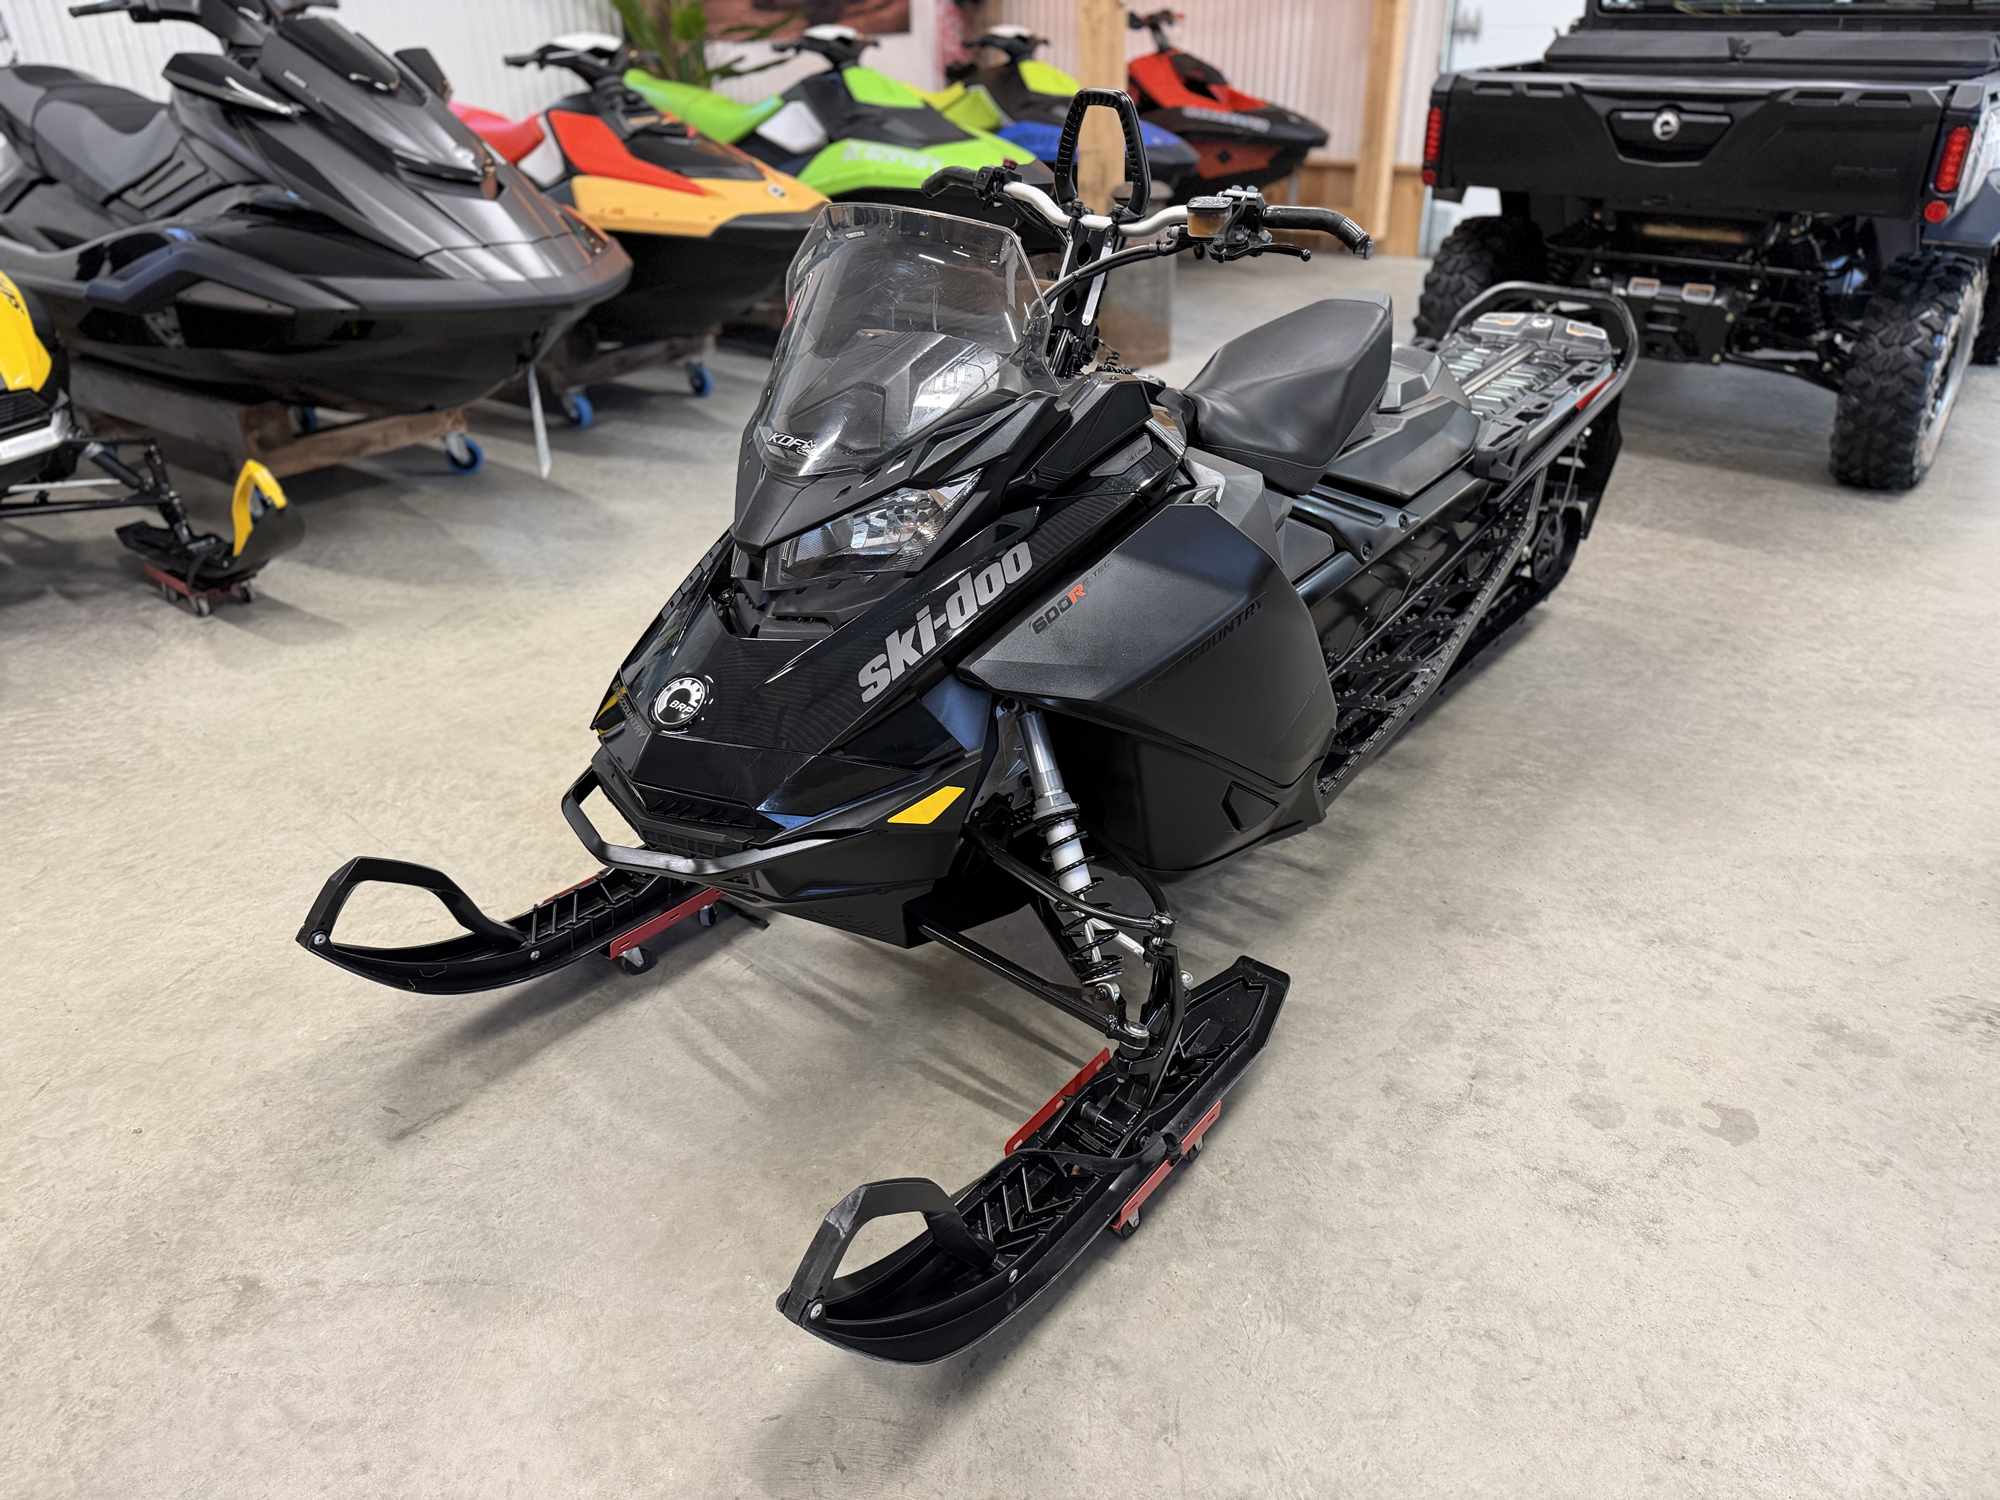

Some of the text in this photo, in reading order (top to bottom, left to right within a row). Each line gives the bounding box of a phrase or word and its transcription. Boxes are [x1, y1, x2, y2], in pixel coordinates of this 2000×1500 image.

[858, 541, 1033, 703] ski-doo
[1031, 584, 1086, 635] 600R
[669, 699, 694, 713] BRP
